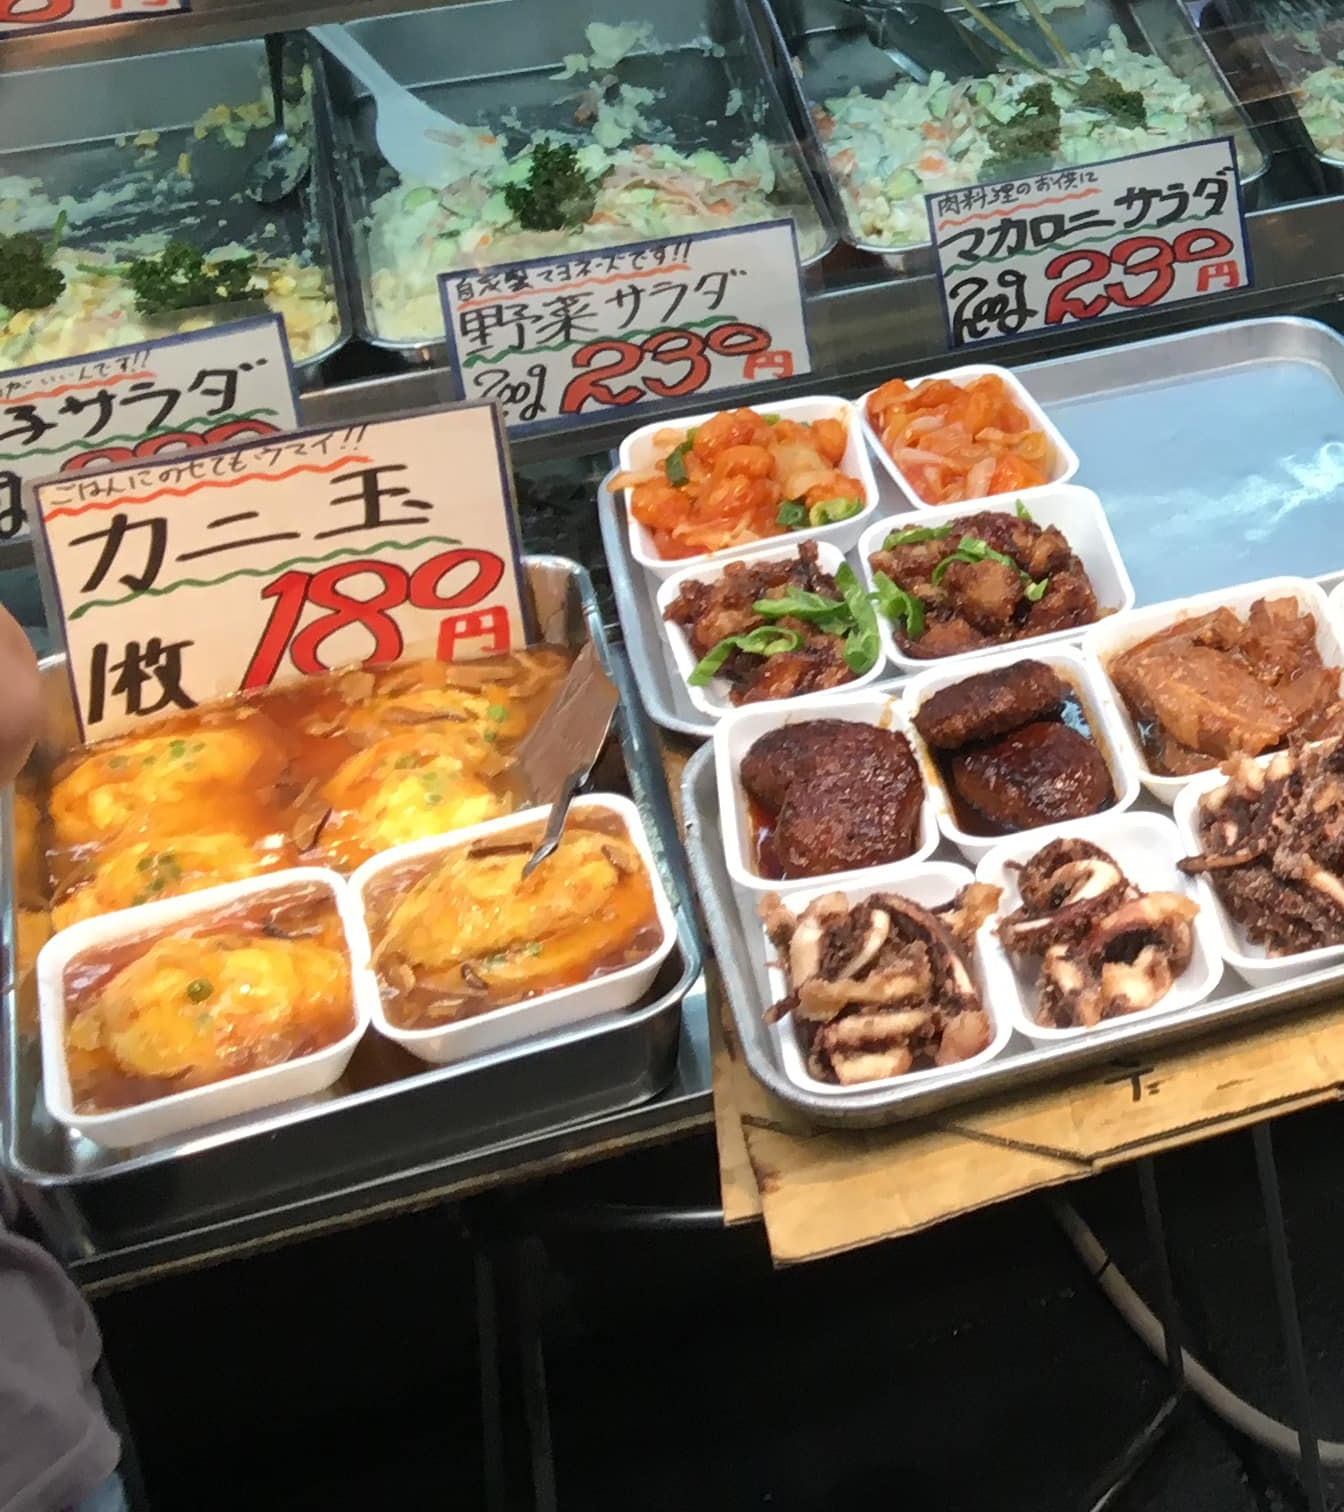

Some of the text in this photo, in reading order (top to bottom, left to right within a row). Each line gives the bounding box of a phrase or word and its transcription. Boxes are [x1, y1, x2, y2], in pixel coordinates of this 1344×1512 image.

[938, 171, 1099, 217] 肉料理のお供に
[938, 165, 1236, 262] マカロニサラダ
[460, 268, 748, 356] 野菜サラダ
[68, 464, 435, 593] カニ玉
[86, 636, 199, 726] 1枚
